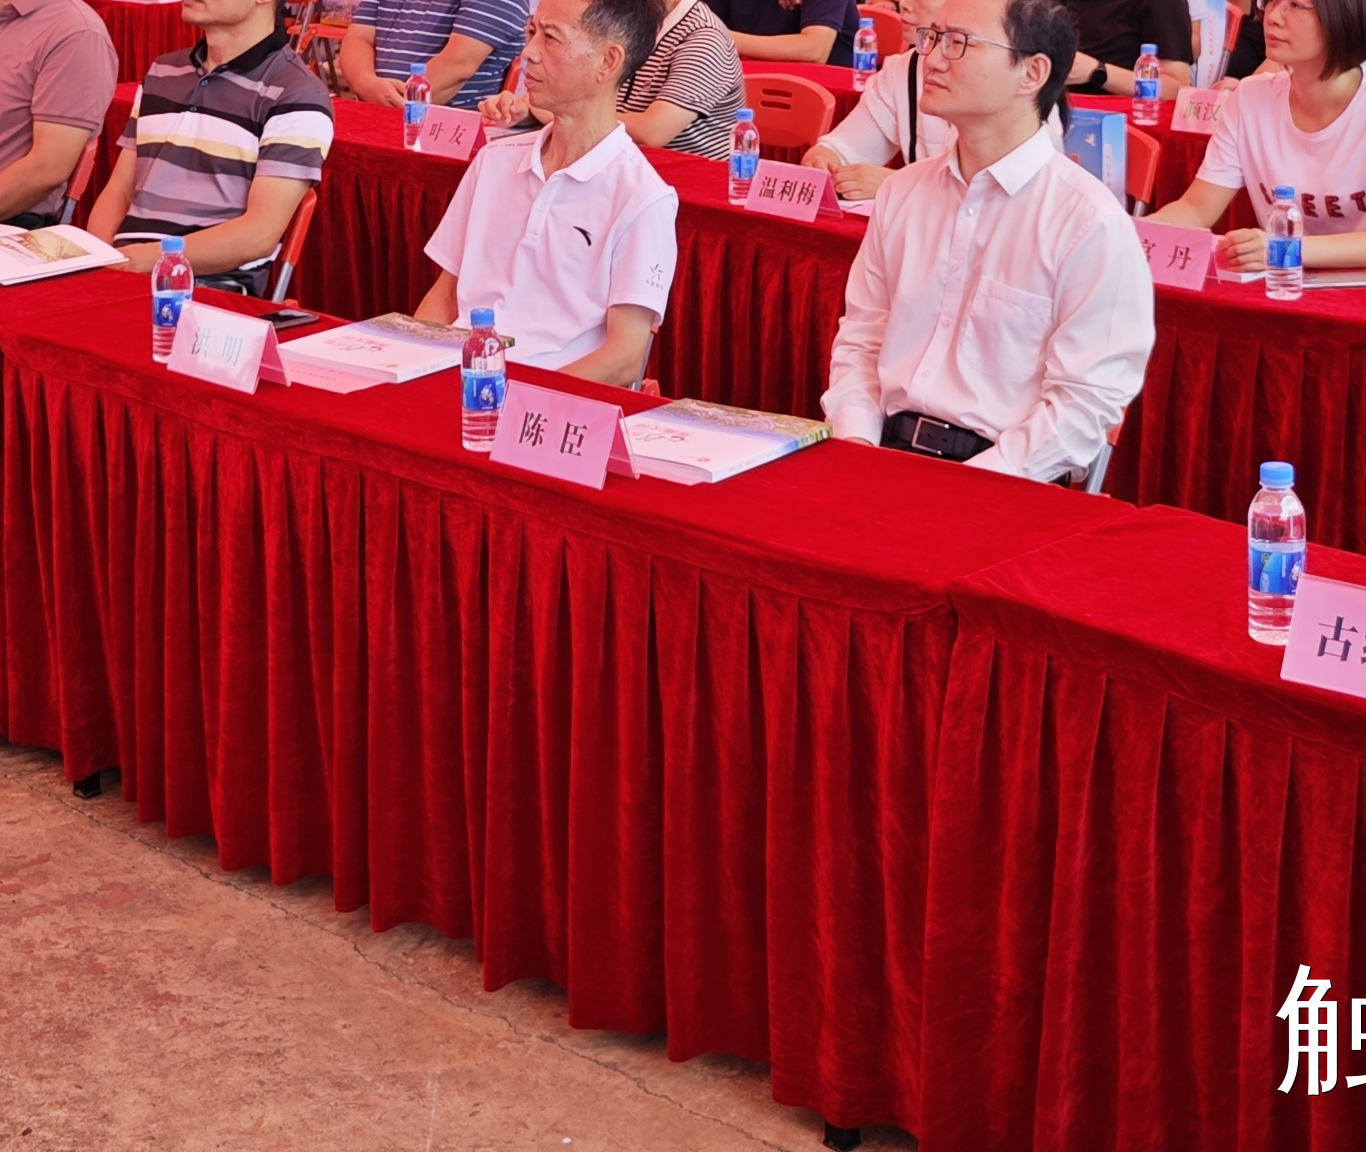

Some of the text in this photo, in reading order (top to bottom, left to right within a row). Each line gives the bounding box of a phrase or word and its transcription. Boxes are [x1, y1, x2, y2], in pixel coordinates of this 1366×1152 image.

[758, 175, 817, 206] 温利梅
[1259, 182, 1366, 218] EET
[519, 411, 591, 457] 陈臣
